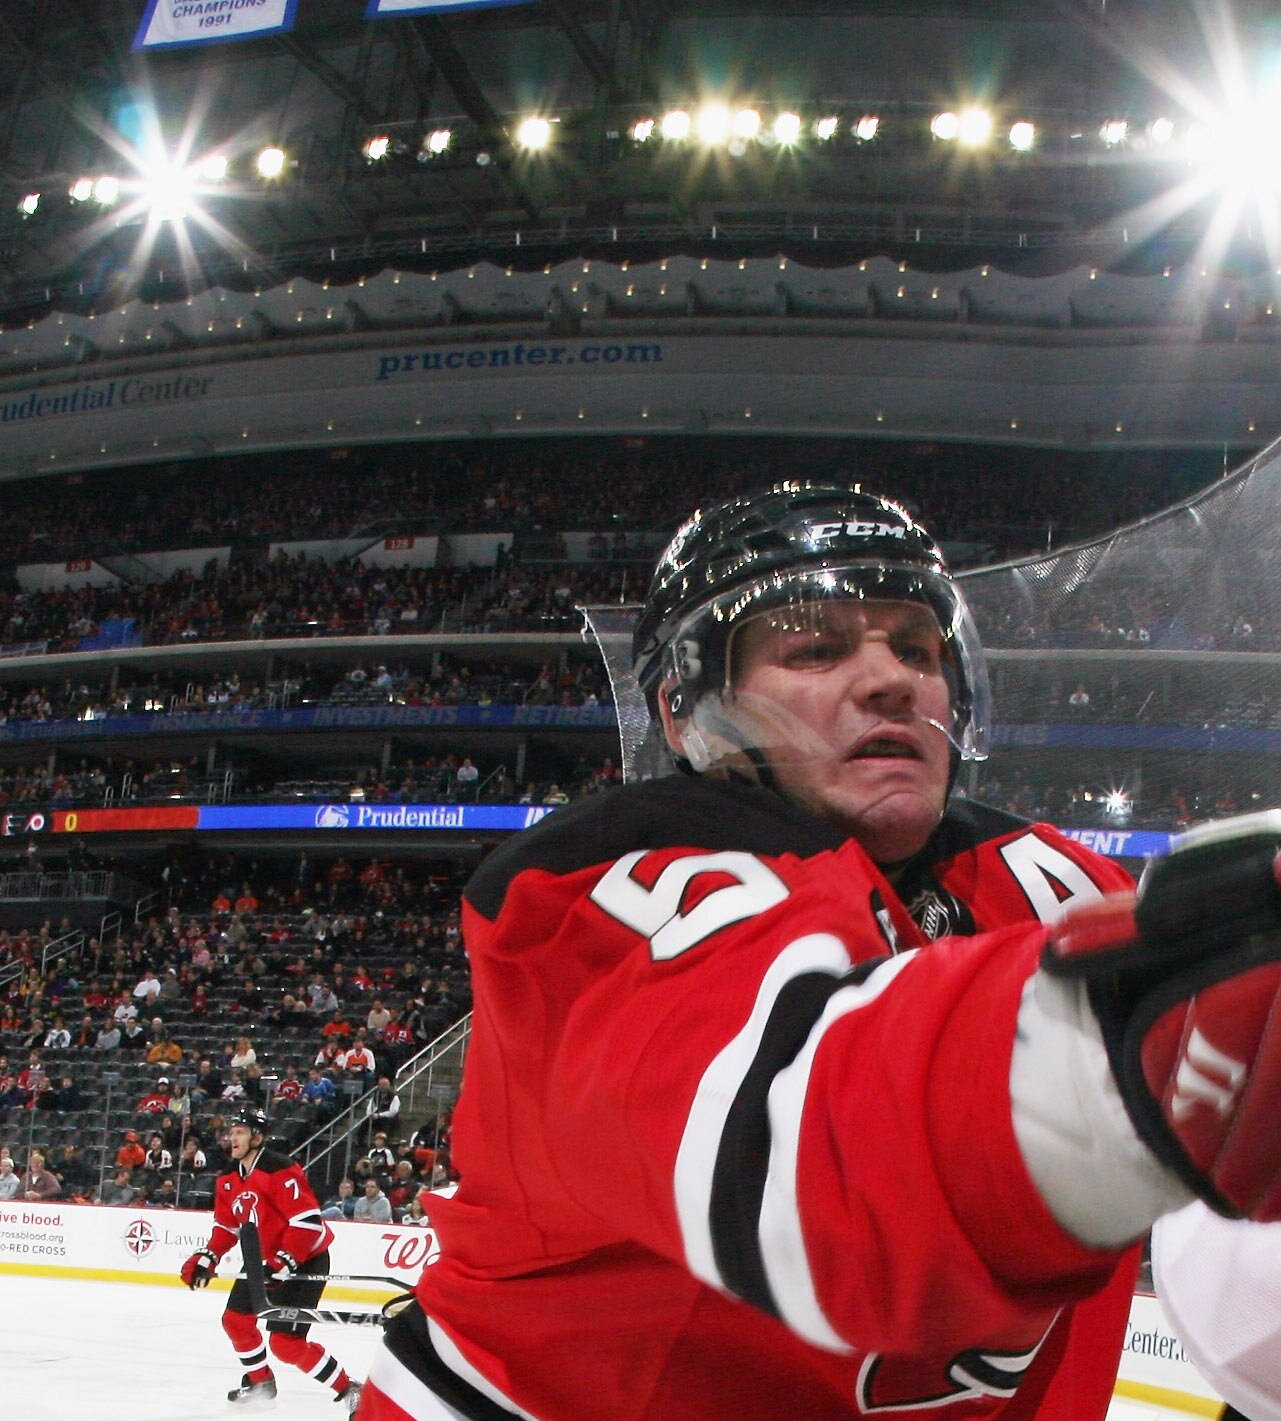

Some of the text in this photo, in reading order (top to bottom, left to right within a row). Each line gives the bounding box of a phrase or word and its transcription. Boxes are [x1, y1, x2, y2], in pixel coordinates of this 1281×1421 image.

[172, 0, 266, 18] CHAMPIONS
[199, 13, 232, 28] 1991
[376, 343, 663, 380] prucenter.com
[0, 375, 214, 422] udential Center
[810, 521, 906, 540] CCM
[312, 705, 458, 727] INVESTMENTS
[65, 813, 78, 831] 0
[357, 806, 464, 829] Prudential
[999, 831, 1106, 926] A
[284, 1178, 300, 1200] 7
[22, 1212, 64, 1226] blood.
[0, 1231, 64, 1244] rossblood.org
[32, 1245, 66, 1256] CROSS
